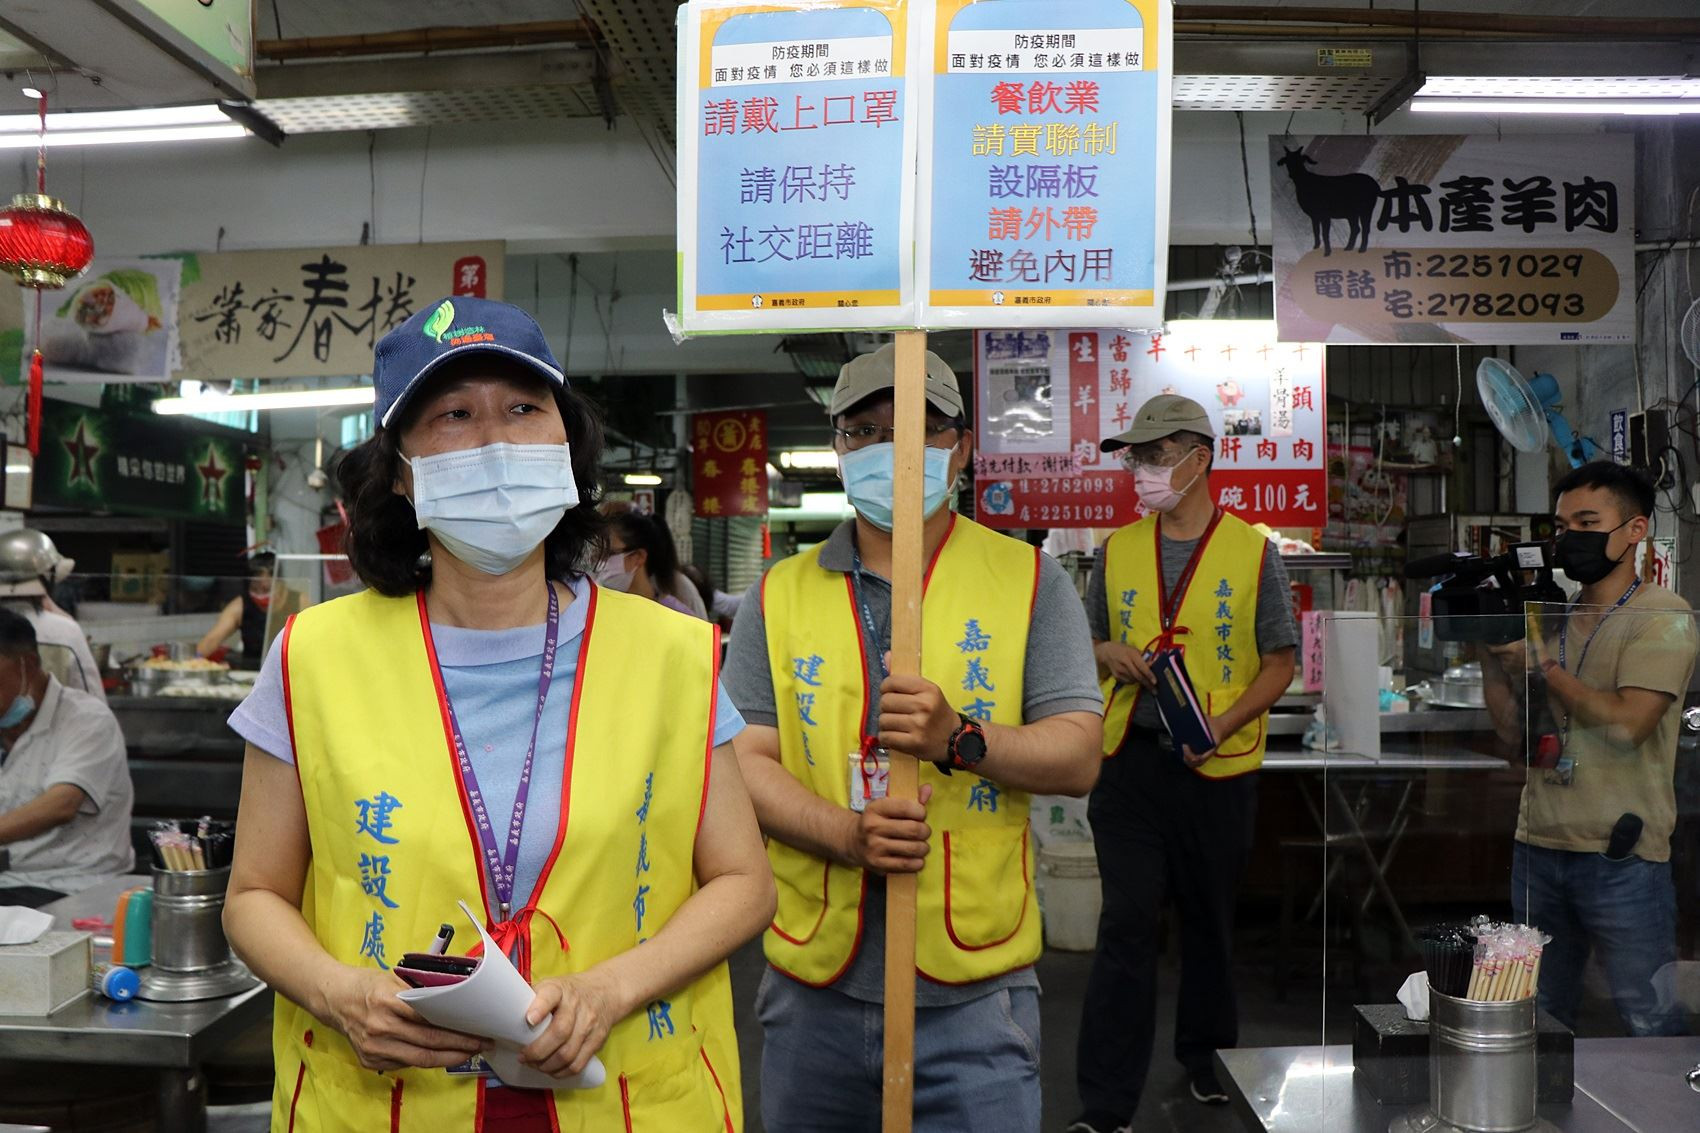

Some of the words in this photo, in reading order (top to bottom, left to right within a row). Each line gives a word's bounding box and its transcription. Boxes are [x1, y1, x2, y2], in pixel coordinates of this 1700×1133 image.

[772, 43, 829, 60] 防疫期間
[1014, 34, 1076, 49] 防疫期間
[715, 65, 777, 82] 面對疫情
[789, 58, 889, 78] 您必須這樣做
[952, 53, 1020, 69] 面對疫情
[1034, 51, 1140, 69] 您必須這樣做
[704, 89, 899, 136] 請戴上口罩
[990, 80, 1100, 115] 餐飲業
[971, 121, 1118, 157] 請實聯制
[740, 163, 856, 204] 請保持
[989, 163, 1099, 199] 設隔板
[1376, 175, 1619, 234] 本產羊肉
[988, 206, 1099, 241] 請外帶
[720, 220, 874, 265] 社交距離
[968, 247, 1113, 284] 避免內用
[771, 298, 805, 307] 嘉義市政府
[1014, 296, 1051, 304] 嘉義市政府
[1314, 269, 1376, 300] 電話
[1214, 578, 1235, 684] 嘉義市政府
[955, 618, 1000, 813] 嘉義市府
[354, 790, 403, 971] 建設處
[632, 771, 675, 1041] 嘉義市府
